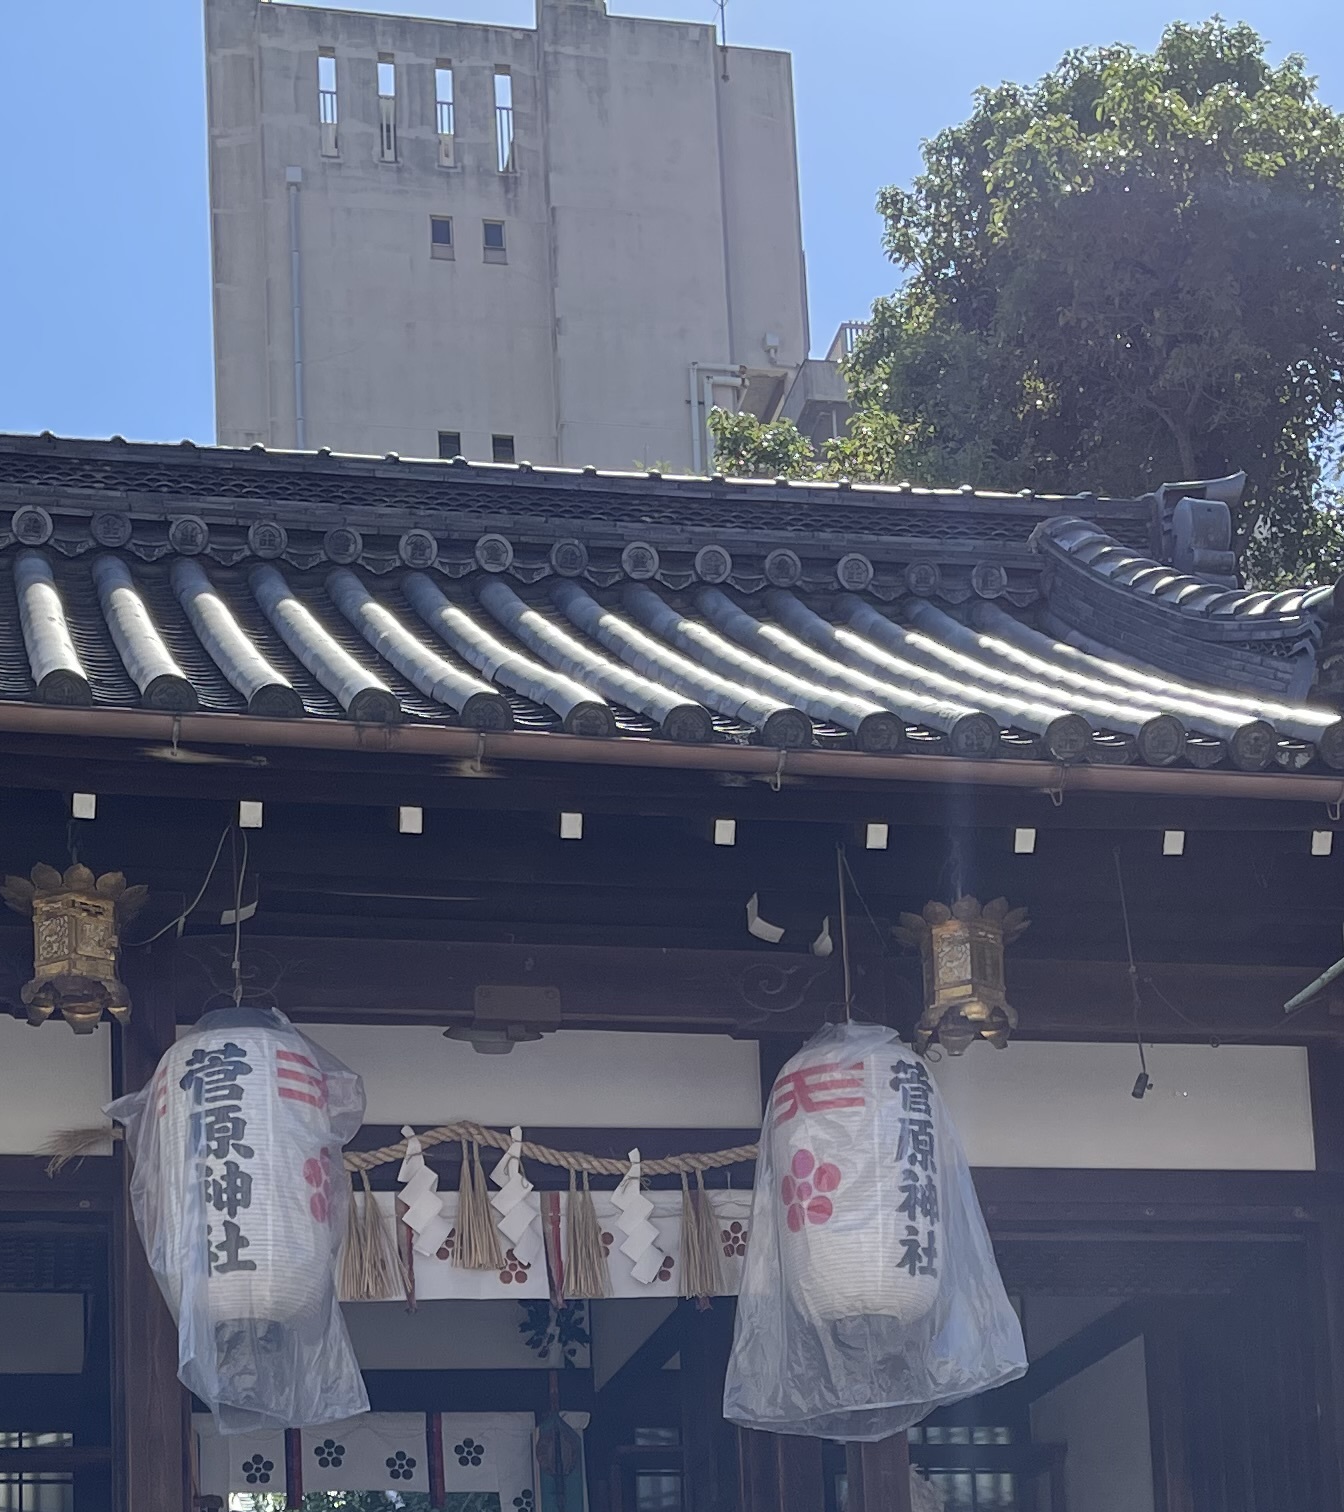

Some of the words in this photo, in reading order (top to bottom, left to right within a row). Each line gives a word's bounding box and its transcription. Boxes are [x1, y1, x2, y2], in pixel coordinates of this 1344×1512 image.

[179, 1042, 257, 1278] 菅原神社
[888, 1059, 940, 1278] 菅原神社
